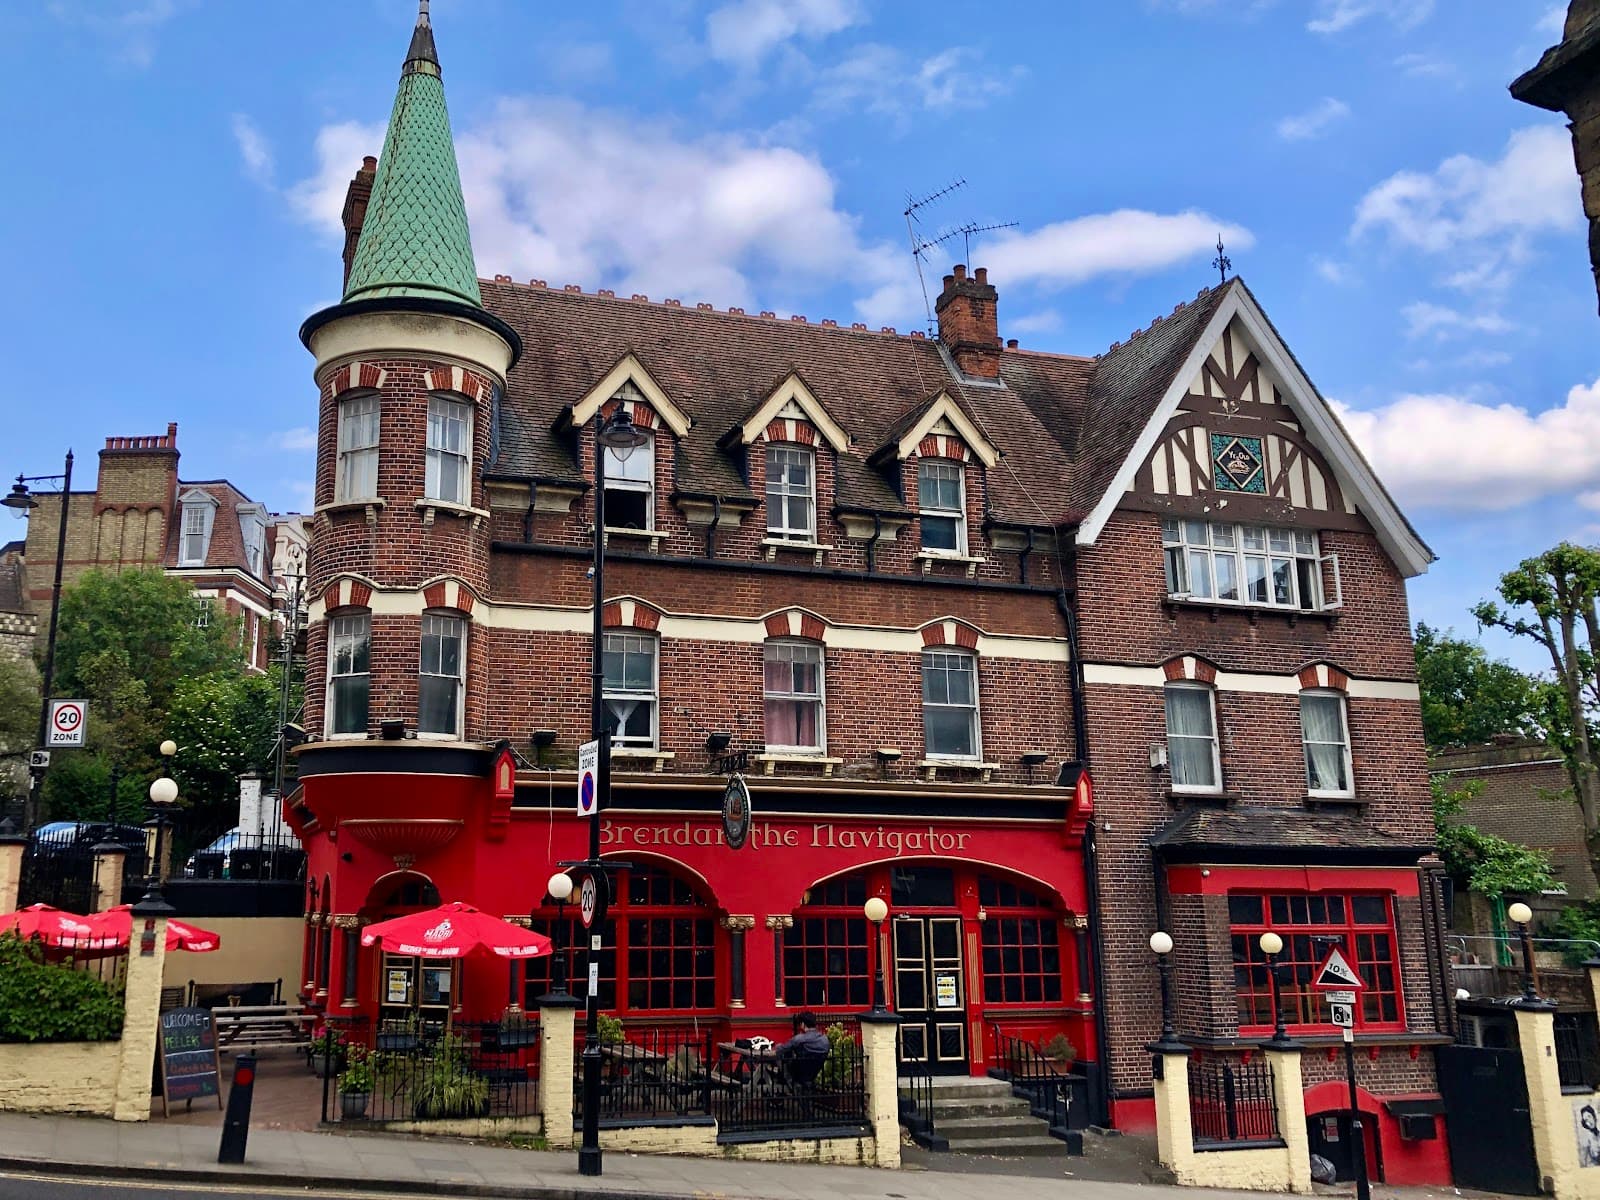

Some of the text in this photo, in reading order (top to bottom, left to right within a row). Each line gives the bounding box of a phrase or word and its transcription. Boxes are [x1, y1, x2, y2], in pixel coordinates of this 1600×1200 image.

[59, 712, 78, 724] 20
[53, 733, 79, 741] ZONE
[749, 822, 799, 850] the
[810, 823, 972, 857] Navigator
[582, 889, 593, 912] 20
[1329, 963, 1348, 977] 10%
[164, 1013, 202, 1028] WELCOME
